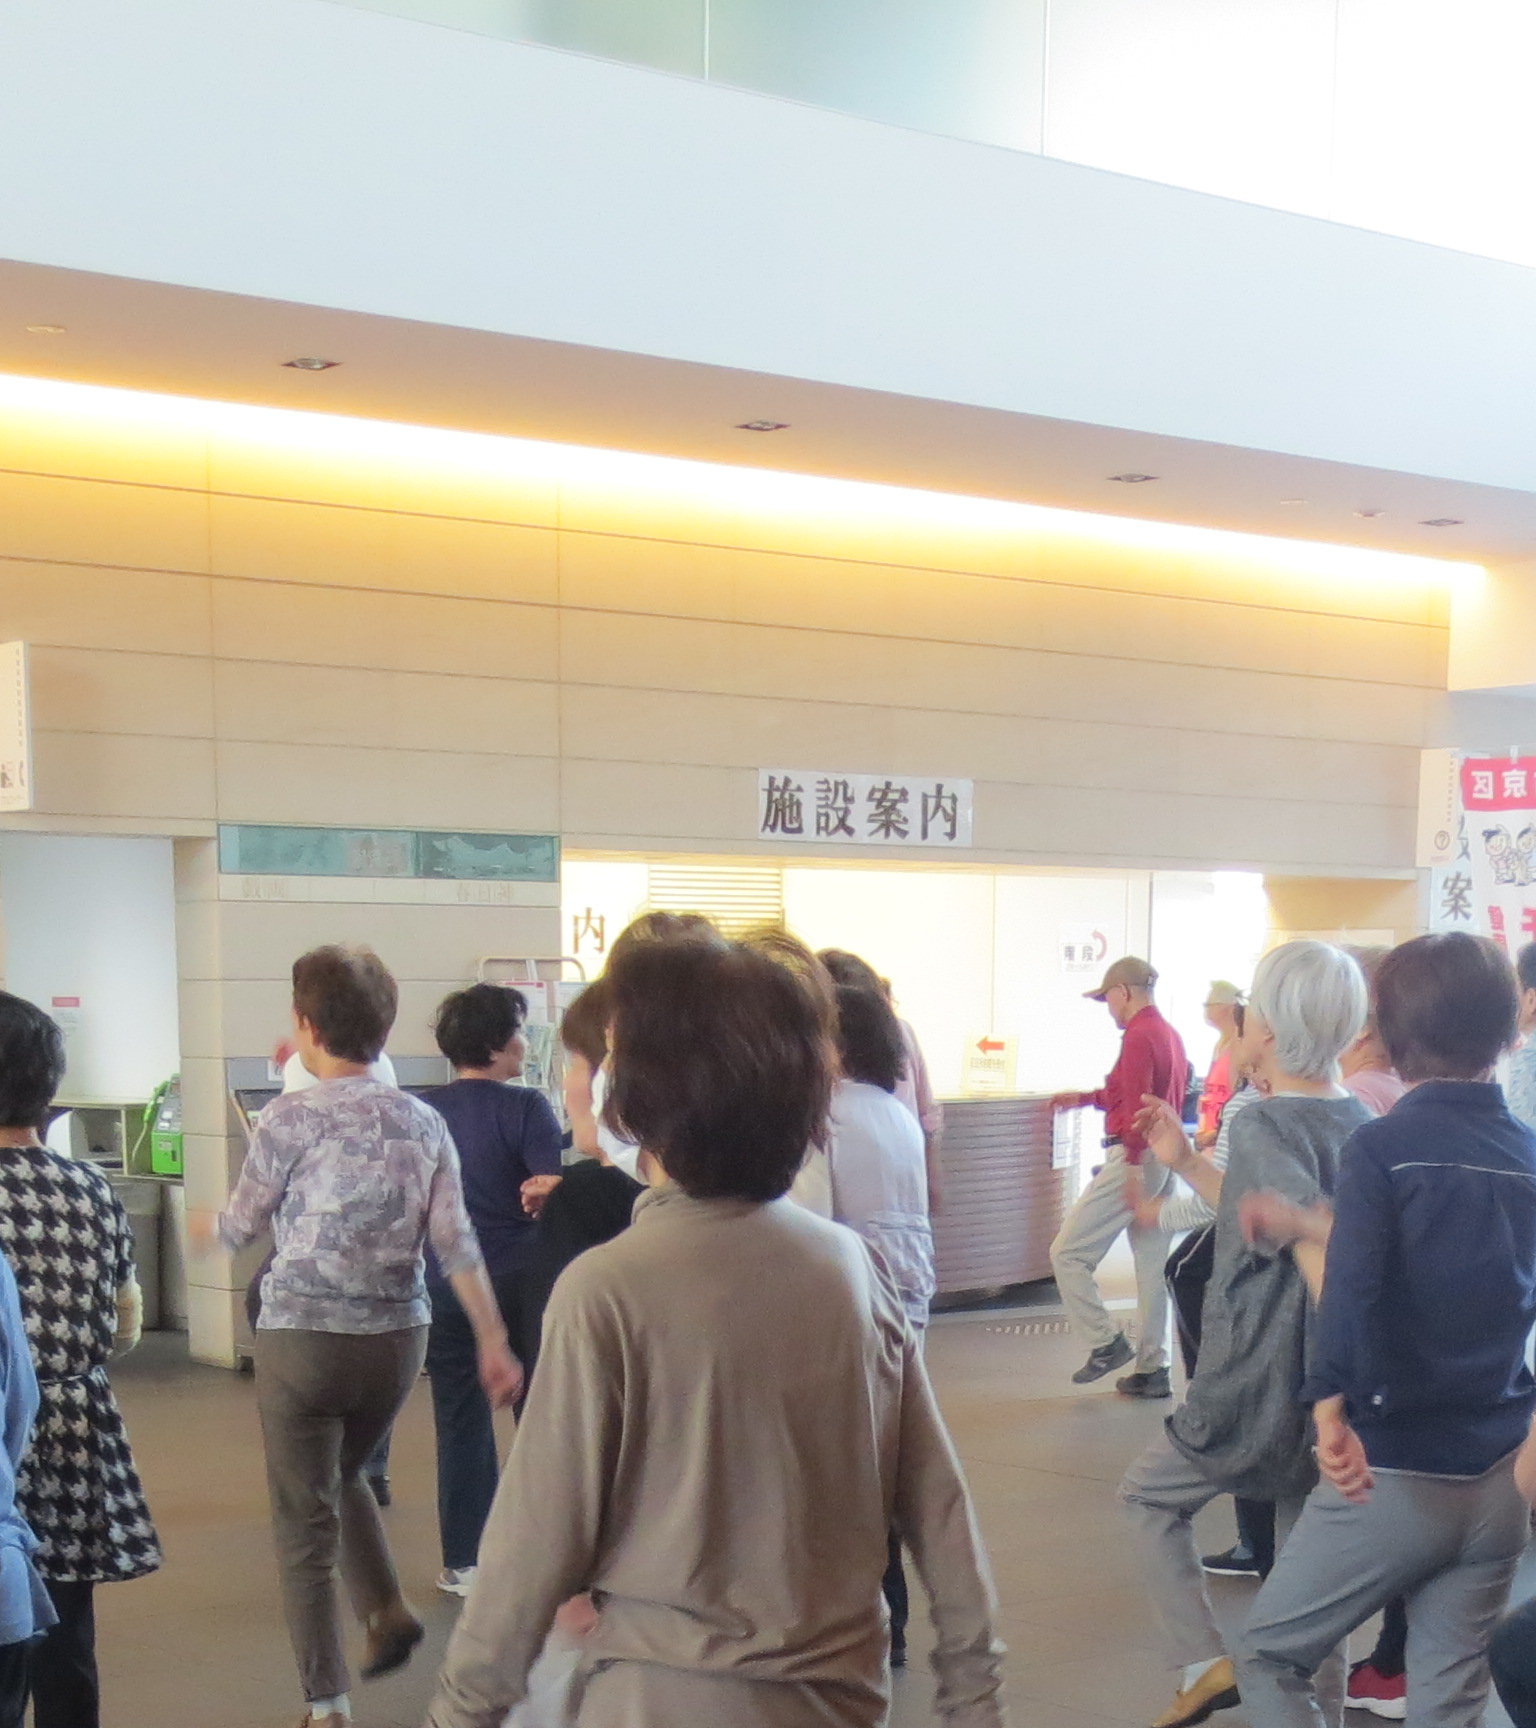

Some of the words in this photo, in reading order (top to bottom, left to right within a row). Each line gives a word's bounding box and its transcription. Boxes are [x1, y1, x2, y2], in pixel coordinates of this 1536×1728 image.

[761, 775, 959, 842] 施設案内
[572, 906, 606, 954] 内
